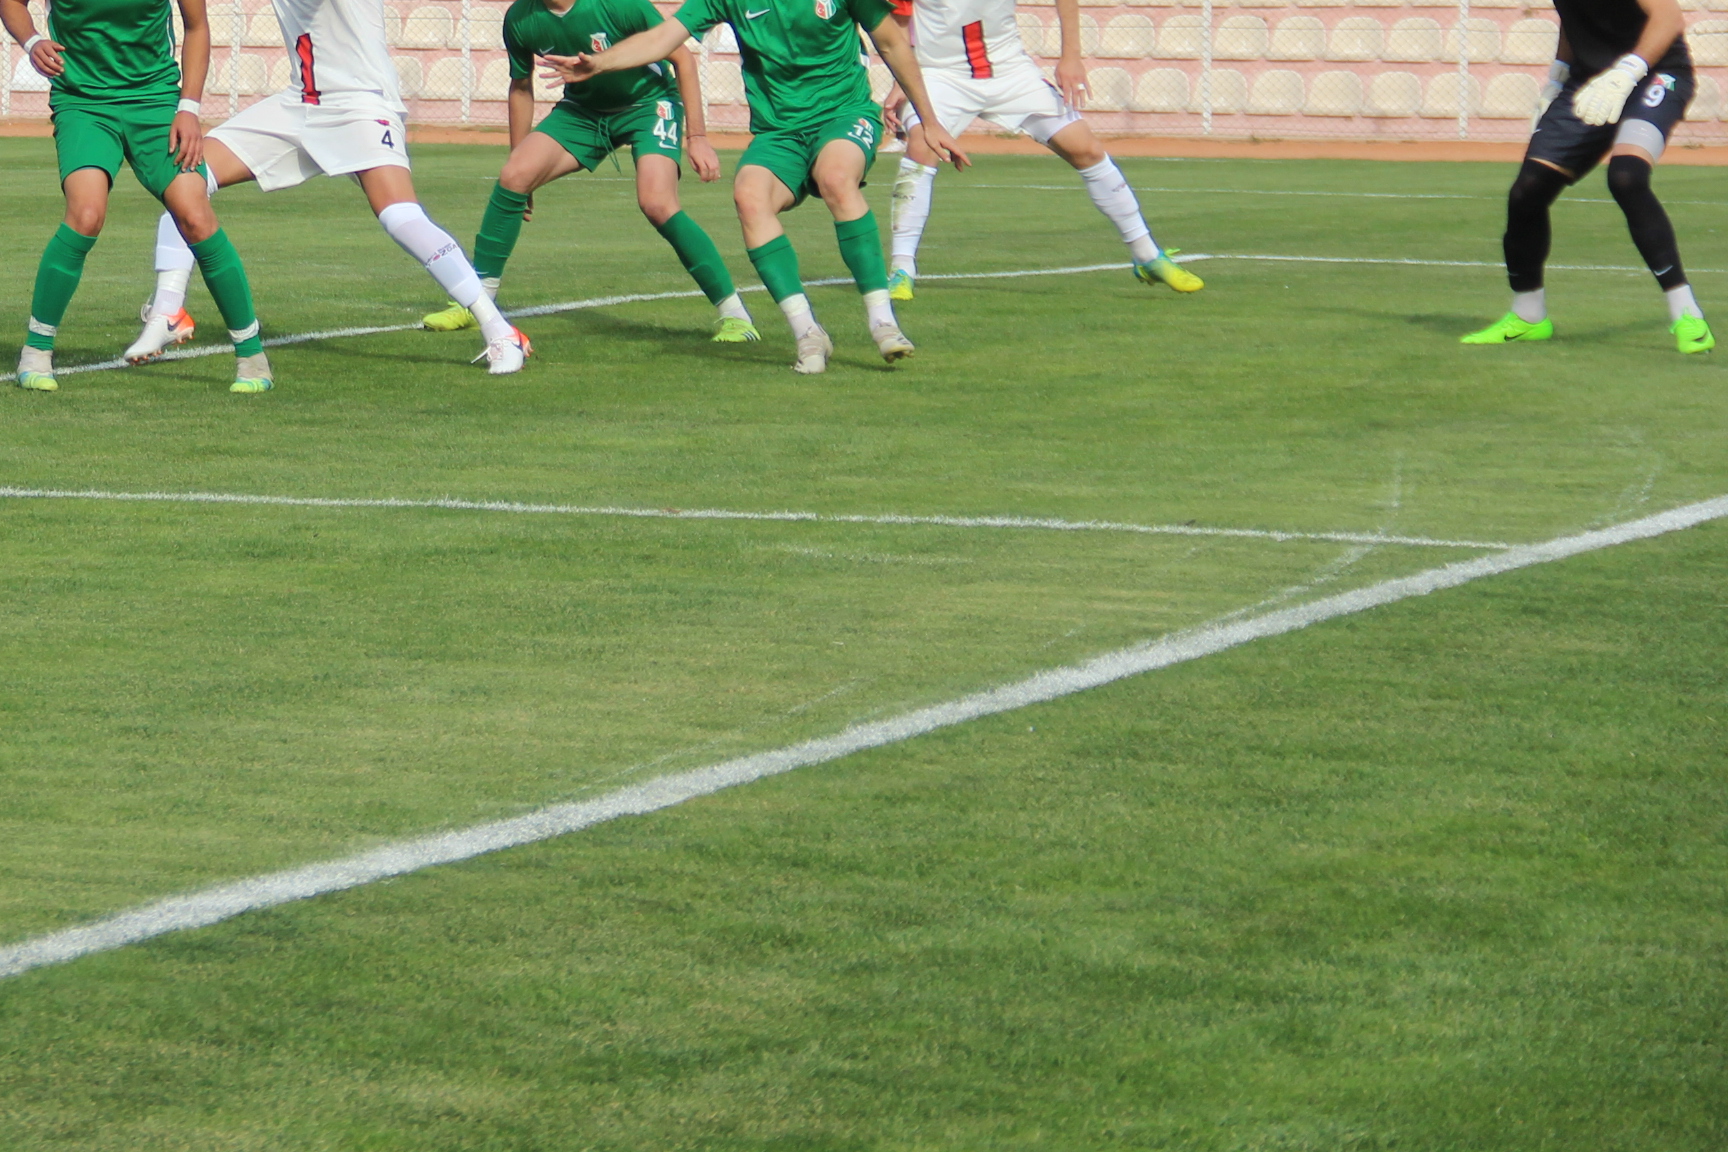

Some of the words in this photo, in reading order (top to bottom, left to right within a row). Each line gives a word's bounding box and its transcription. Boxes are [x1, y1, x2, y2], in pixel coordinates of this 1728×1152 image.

[1643, 84, 1666, 107] 9
[381, 130, 395, 149] 4
[653, 118, 678, 146] 44
